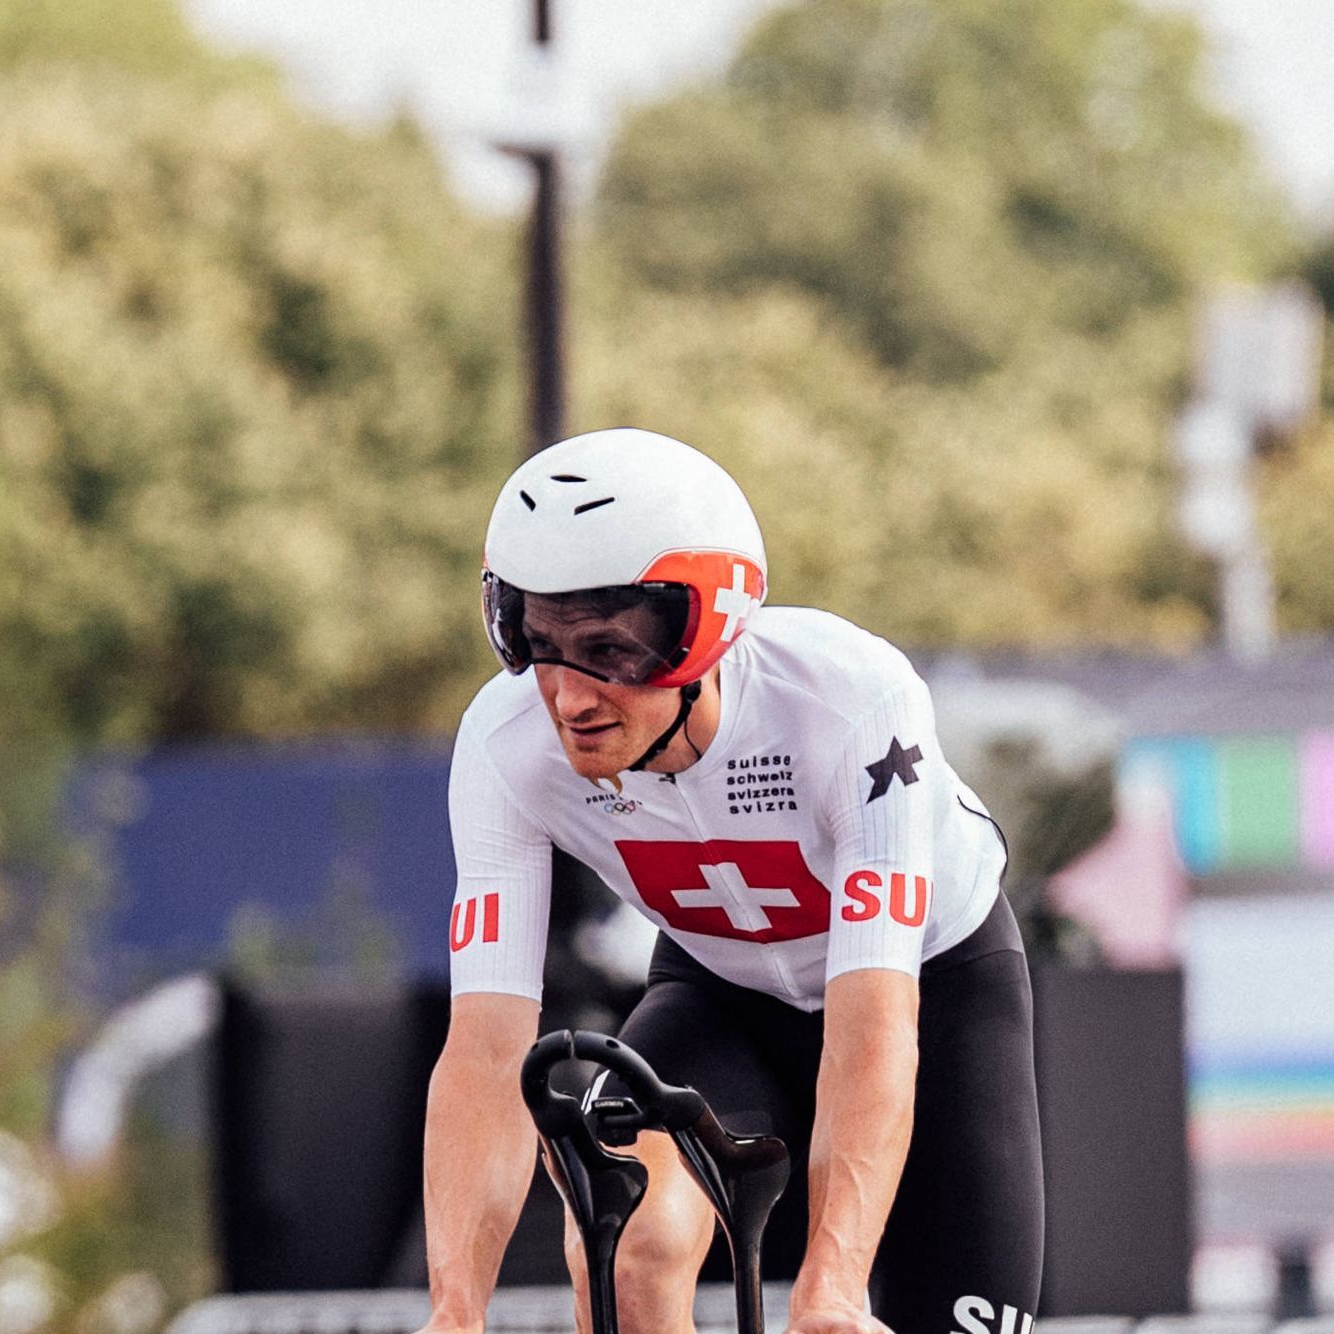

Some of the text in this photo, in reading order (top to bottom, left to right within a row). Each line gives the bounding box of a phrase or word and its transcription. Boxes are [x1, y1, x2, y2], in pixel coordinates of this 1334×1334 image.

[727, 755, 792, 770] suisse
[726, 770, 793, 785] schweiz
[727, 786, 795, 801] svizzera
[729, 800, 798, 815] svizra
[841, 870, 934, 928] SU
[450, 892, 500, 953] UI
